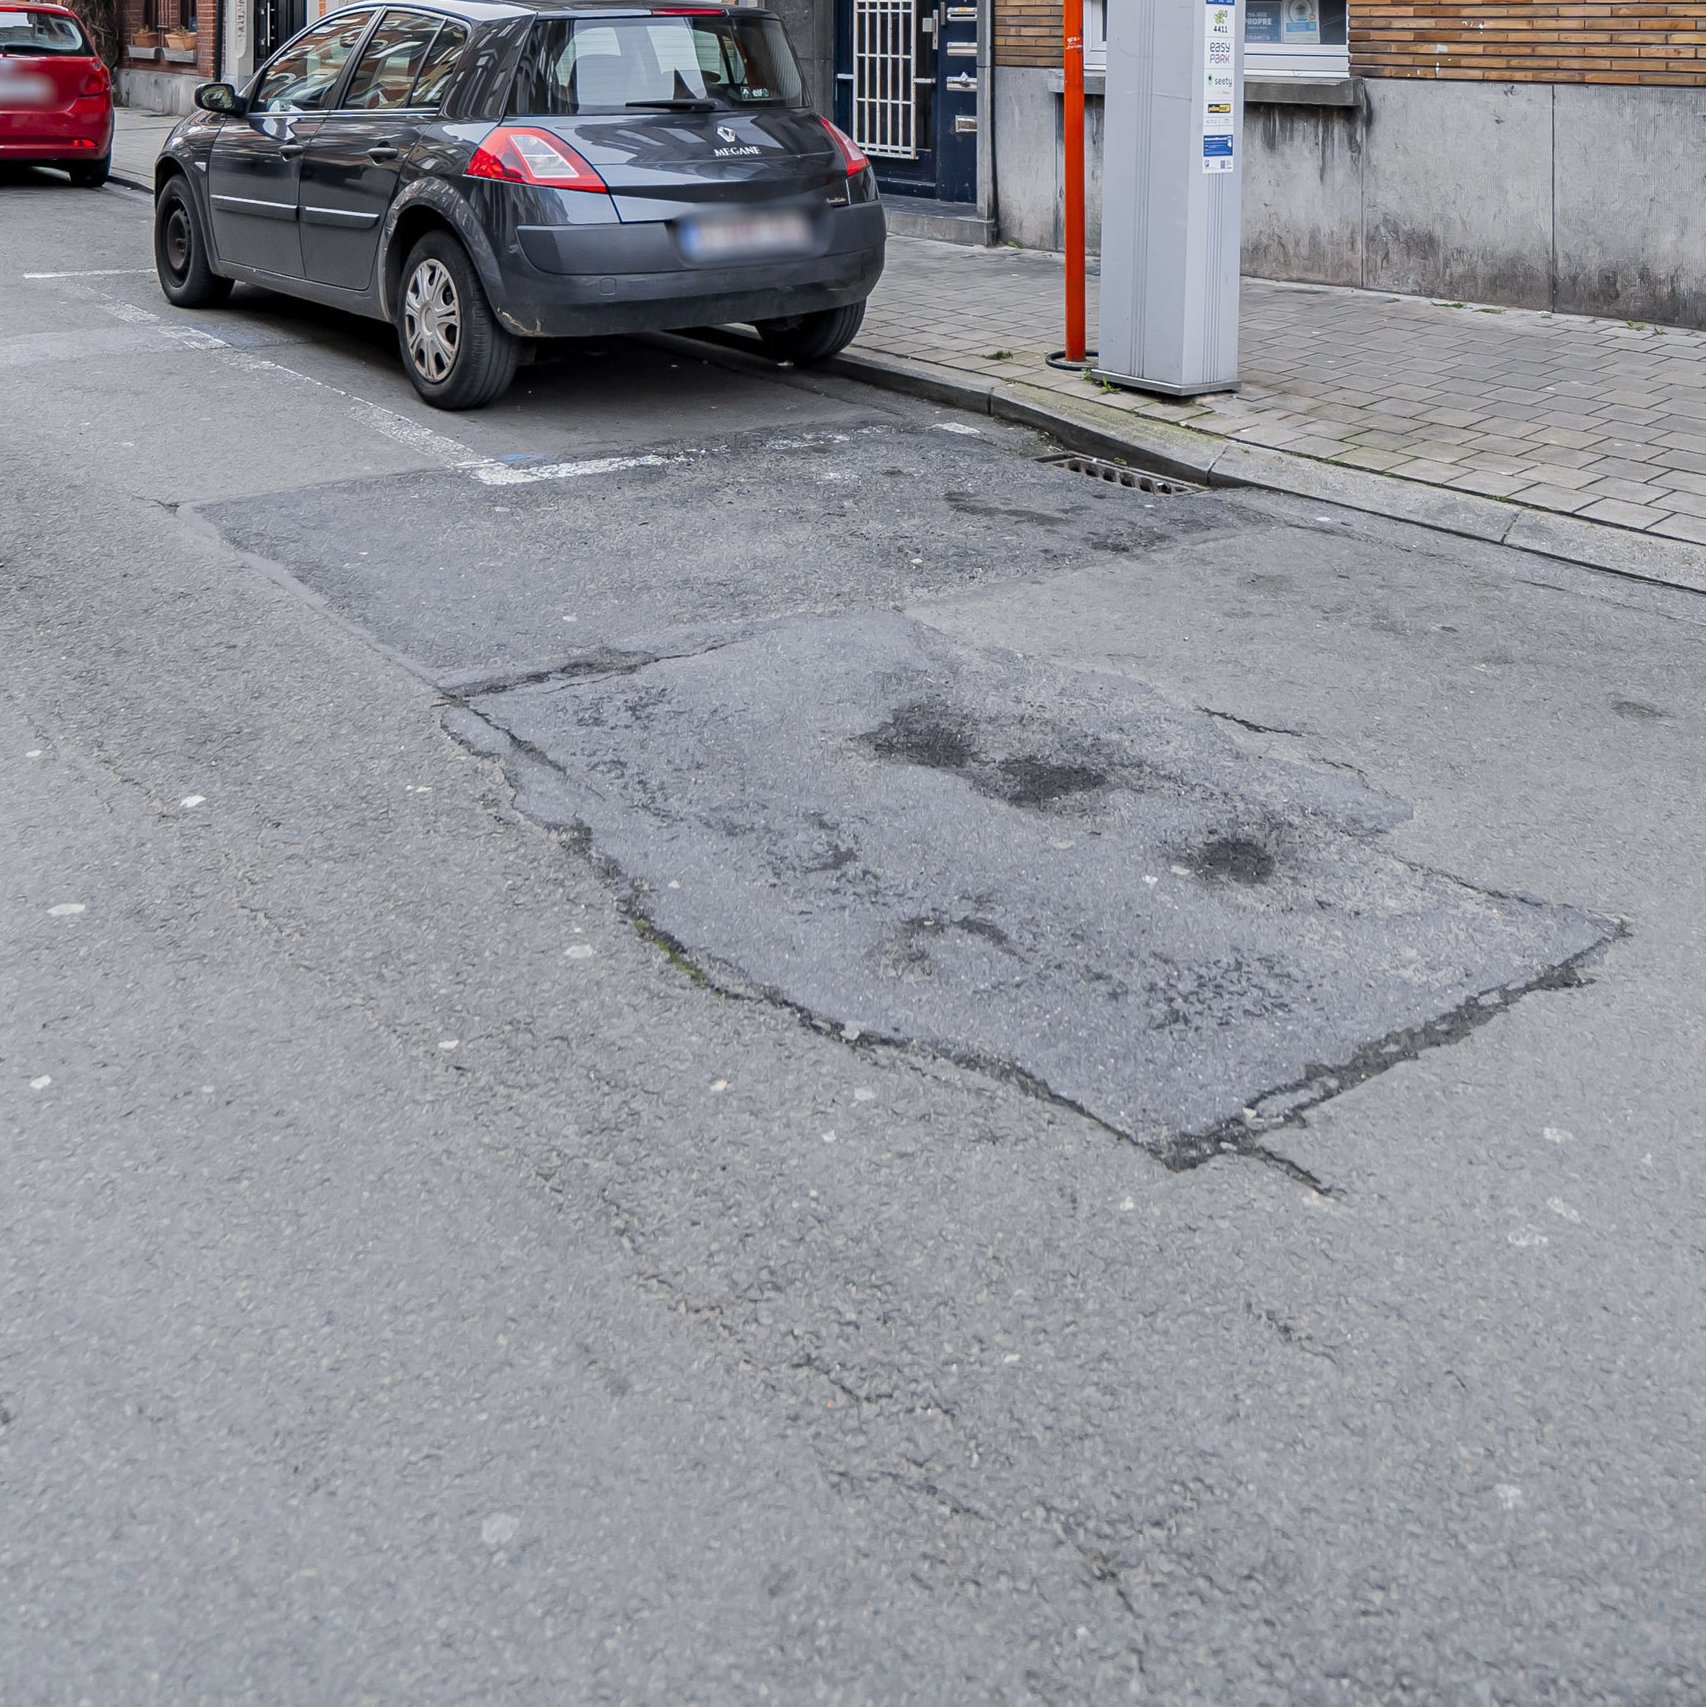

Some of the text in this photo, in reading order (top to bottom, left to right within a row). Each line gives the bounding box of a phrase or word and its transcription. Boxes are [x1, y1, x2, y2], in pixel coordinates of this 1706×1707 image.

[1213, 25, 1228, 33] 4411
[1209, 42, 1231, 53] easy
[1214, 77, 1233, 87] seety
[714, 146, 762, 157] MEGANE
